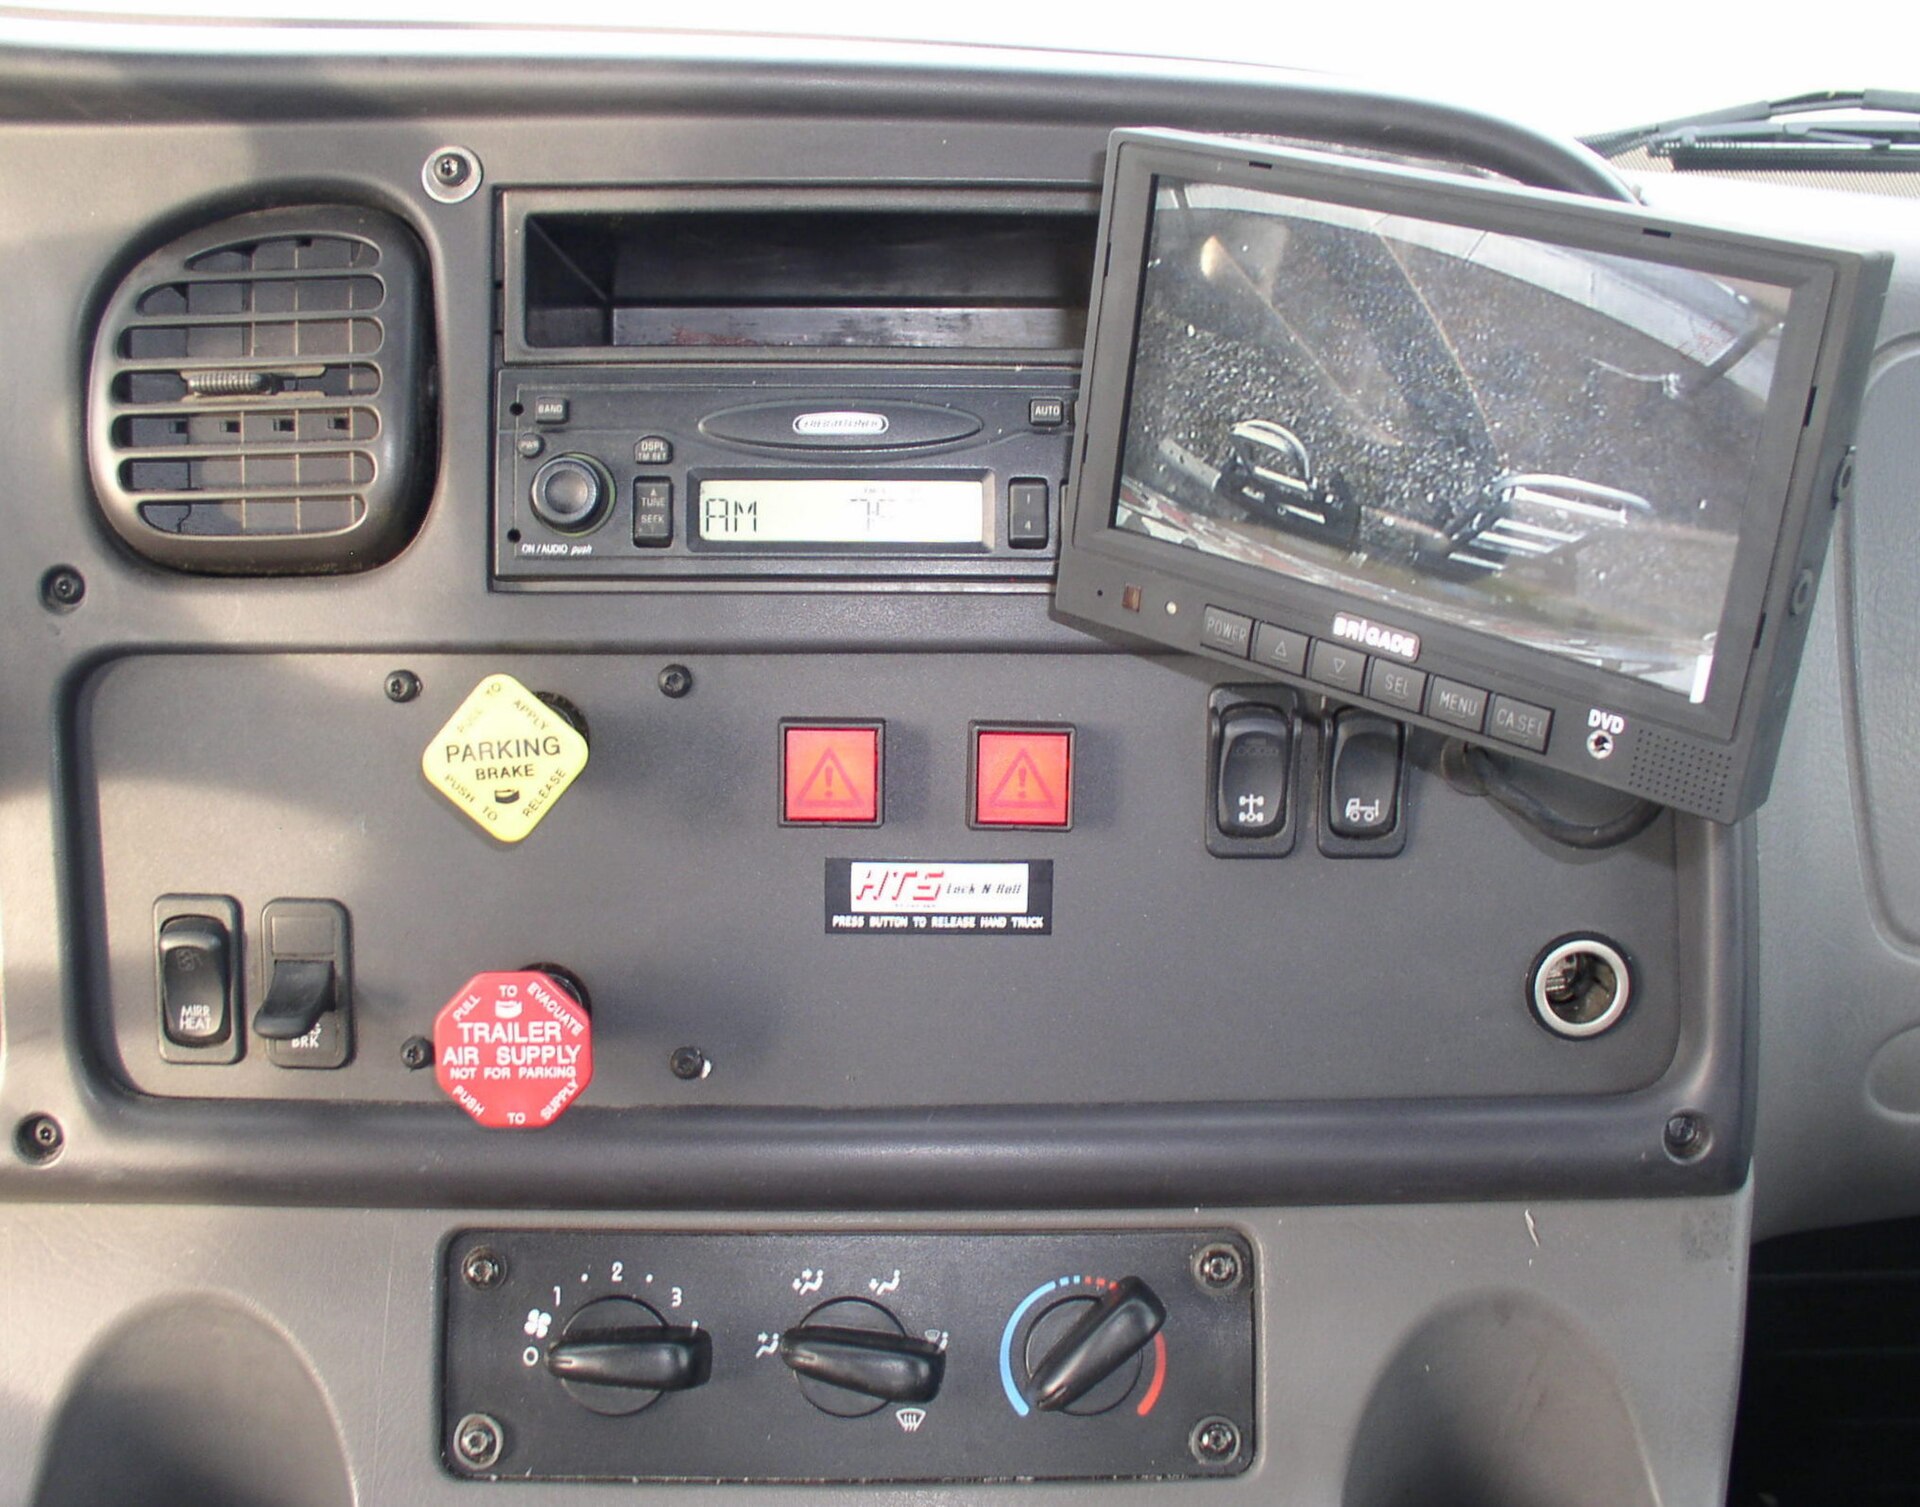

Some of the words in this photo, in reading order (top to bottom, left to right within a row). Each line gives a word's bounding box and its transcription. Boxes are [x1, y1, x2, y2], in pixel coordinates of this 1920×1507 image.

[538, 403, 563, 414] BAND
[1035, 405, 1060, 416] AUTO
[641, 441, 665, 451] DSPL
[641, 497, 665, 507] TUNE
[641, 514, 665, 523] SEEK
[705, 498, 757, 532] AM
[570, 544, 592, 556] push
[1205, 617, 1247, 643] POWER
[1385, 674, 1409, 696] SEL
[1440, 690, 1478, 717] MENU
[513, 699, 550, 731] APPLY
[1587, 708, 1625, 735] DVD
[446, 736, 561, 763] PARKING
[475, 764, 535, 780] BRAKE
[444, 773, 476, 803] PUSH
[482, 806, 499, 821] TO
[522, 768, 566, 817] RELEASE
[996, 882, 1022, 895] Roll
[832, 914, 865, 928] PRESS
[869, 915, 908, 928] BUTTON
[912, 915, 927, 928] TO
[931, 915, 976, 928] RELEASE
[980, 916, 1007, 928] HAND
[1011, 916, 1043, 929] TRUCK
[499, 985, 517, 998] TO
[181, 1004, 211, 1016] MIRR
[452, 994, 481, 1022] PULL
[527, 981, 585, 1037] EVACUATE
[179, 1017, 211, 1031] HEAT
[457, 1021, 561, 1044] TRAILER
[442, 1046, 480, 1066] AIR
[496, 1044, 581, 1066] SUPPLY
[450, 1067, 477, 1080] NOT
[484, 1067, 511, 1079] FOR
[518, 1066, 577, 1079] PARKING
[452, 1085, 485, 1117] PUSH
[540, 1078, 579, 1121] SUPPLY
[507, 1112, 526, 1125] TO
[611, 1261, 624, 1281] 2
[553, 1286, 561, 1306] 1
[671, 1287, 682, 1307] 3
